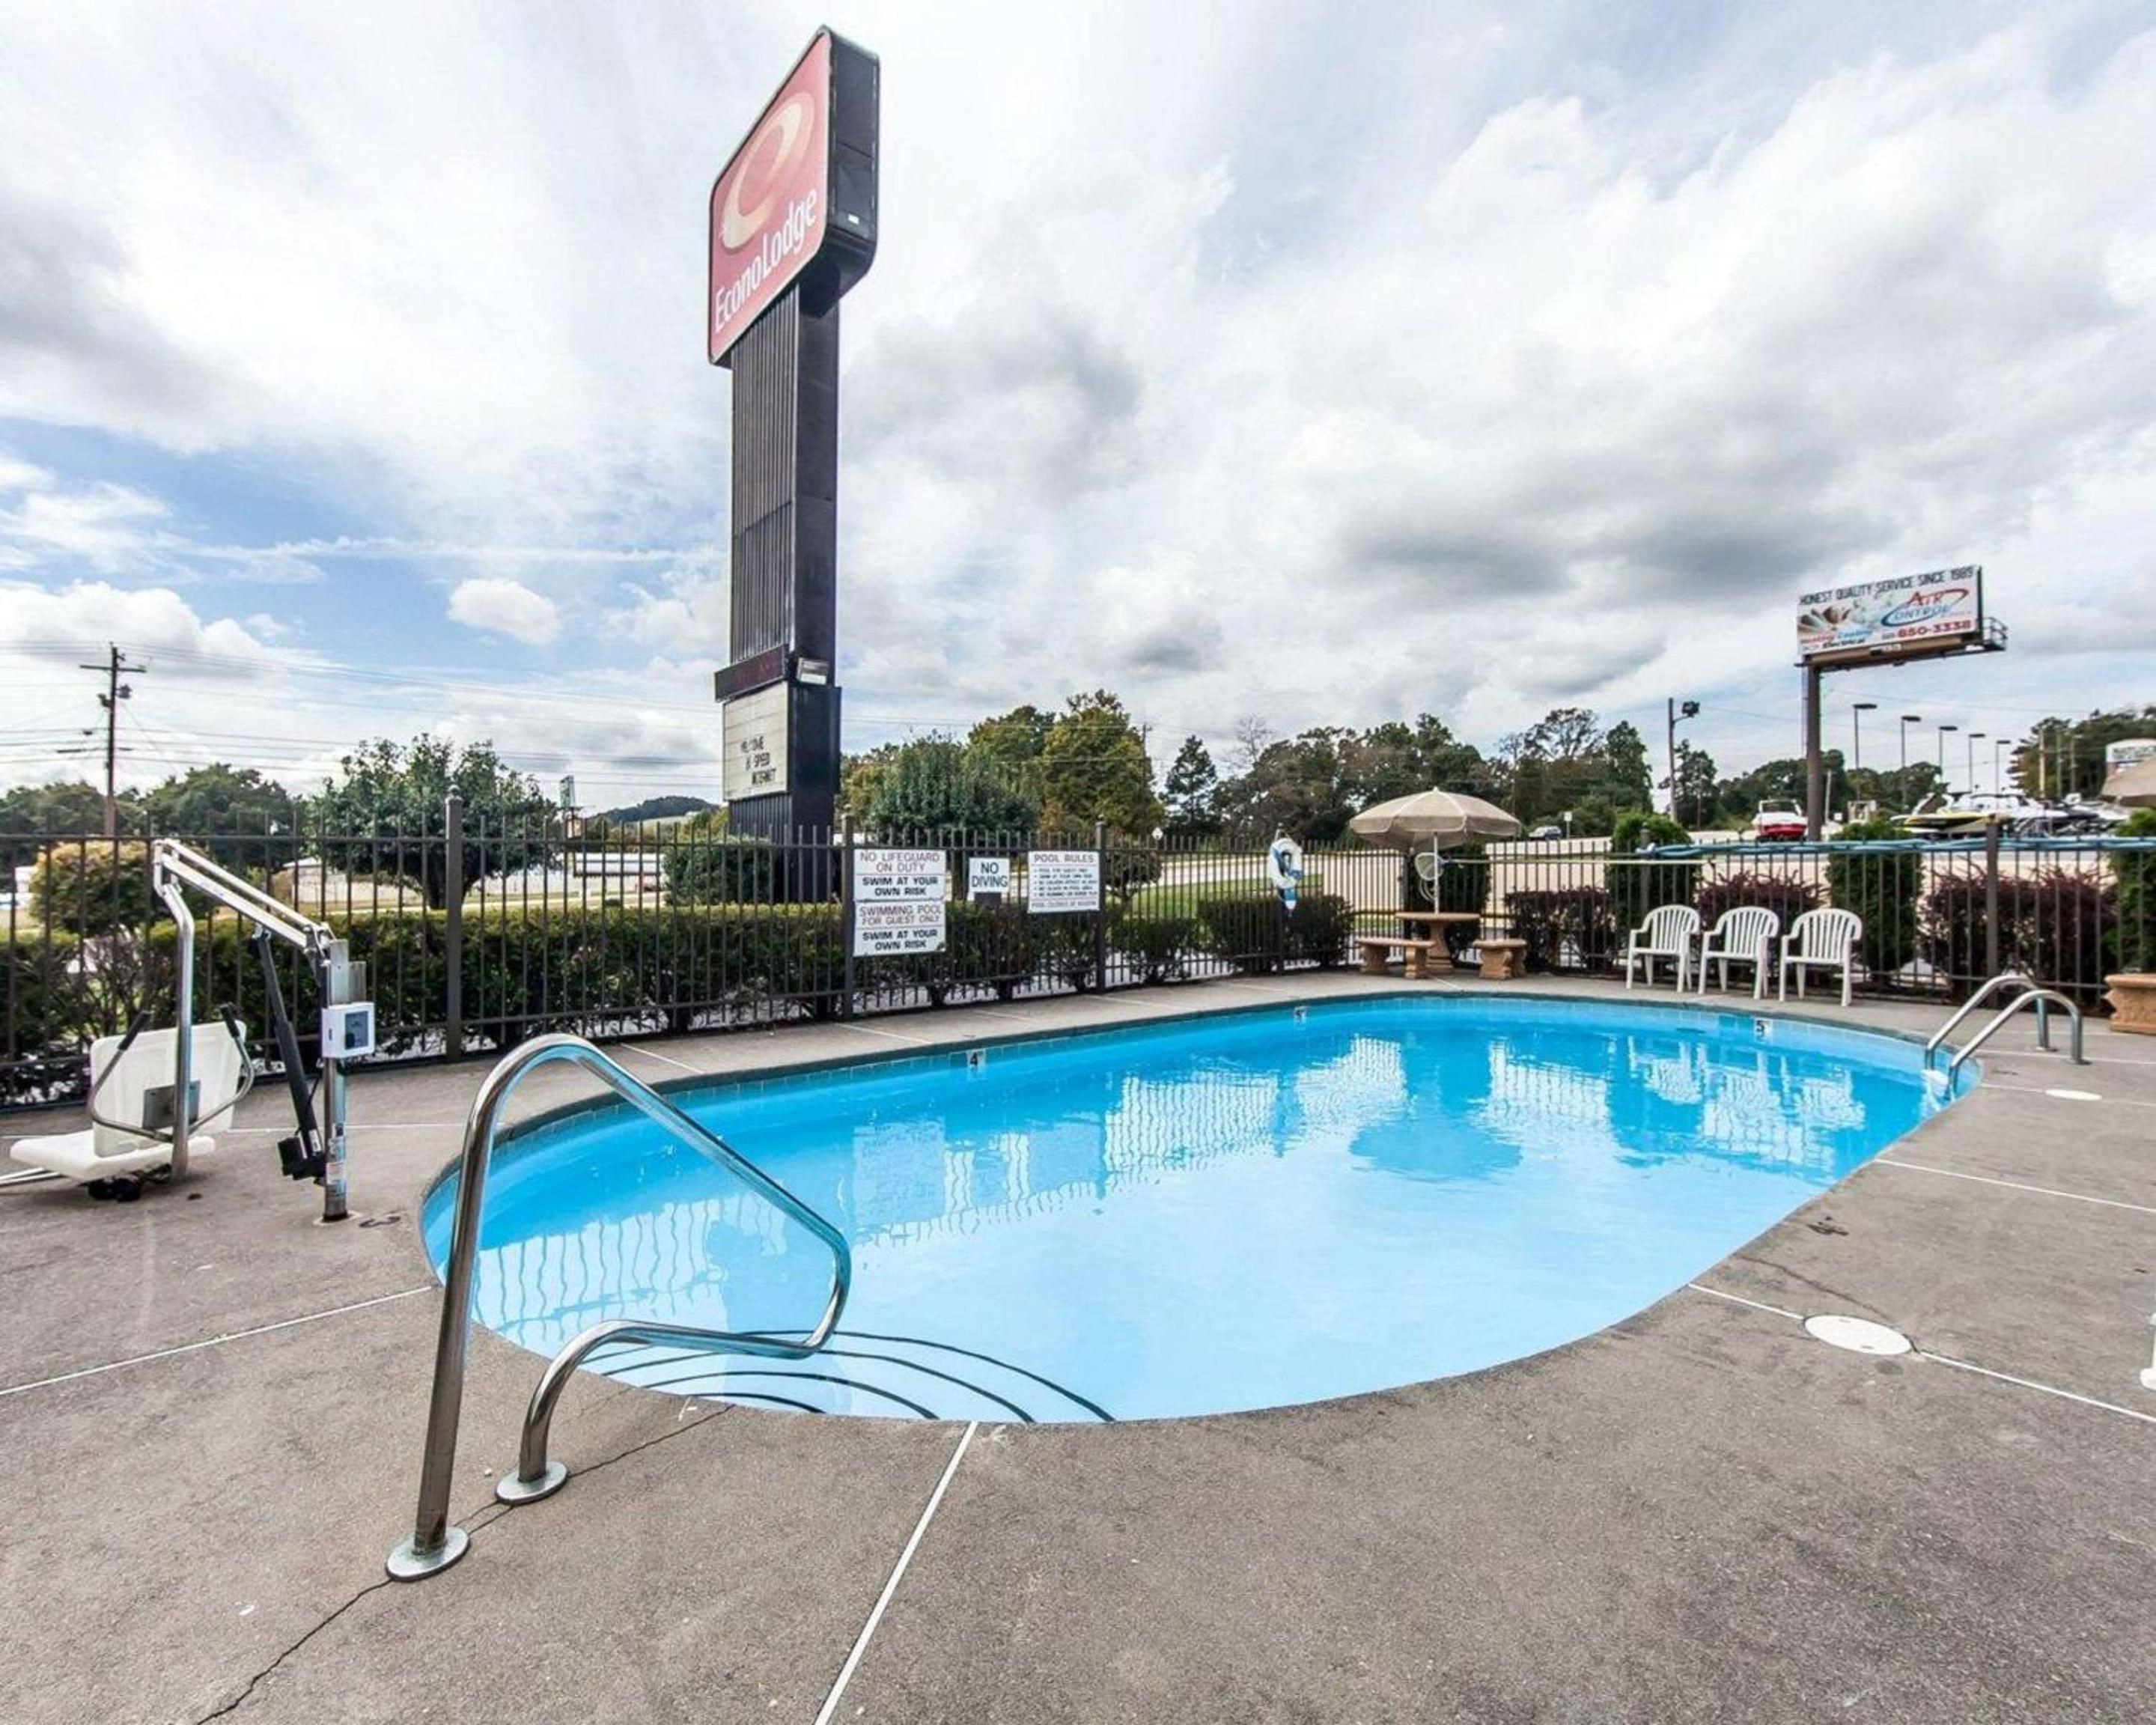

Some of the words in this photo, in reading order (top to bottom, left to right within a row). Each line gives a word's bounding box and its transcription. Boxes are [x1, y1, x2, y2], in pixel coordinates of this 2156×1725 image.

[1799, 591, 1833, 605] HONEST
[1836, 582, 1872, 600] QUALITY
[1875, 576, 1913, 594] SERVICE
[1917, 571, 1945, 585] SINCE
[860, 852, 877, 862] NO
[882, 852, 940, 862] LIFEGUARD
[1035, 854, 1059, 863] POOL
[1065, 854, 1094, 863] RULES
[876, 862, 892, 872] ON
[897, 862, 925, 872] DUTY
[981, 862, 999, 874] NO
[862, 877, 892, 886] SWIM
[897, 876, 908, 885] AT
[913, 876, 938, 885] YOUR
[972, 874, 1008, 888] DIVING
[874, 886, 900, 896] OWN
[904, 886, 927, 895] RISK
[859, 905, 913, 917] SWIMMING
[918, 904, 941, 914] POOL
[862, 916, 881, 925] FOR
[886, 915, 915, 925] GUEST
[919, 914, 940, 923] ONLY
[862, 931, 892, 940] SWIM
[897, 930, 908, 939] AT
[913, 929, 938, 938] YOUR
[875, 941, 900, 950] OWN
[904, 940, 927, 949] RISK
[969, 1051, 978, 1066] 4
